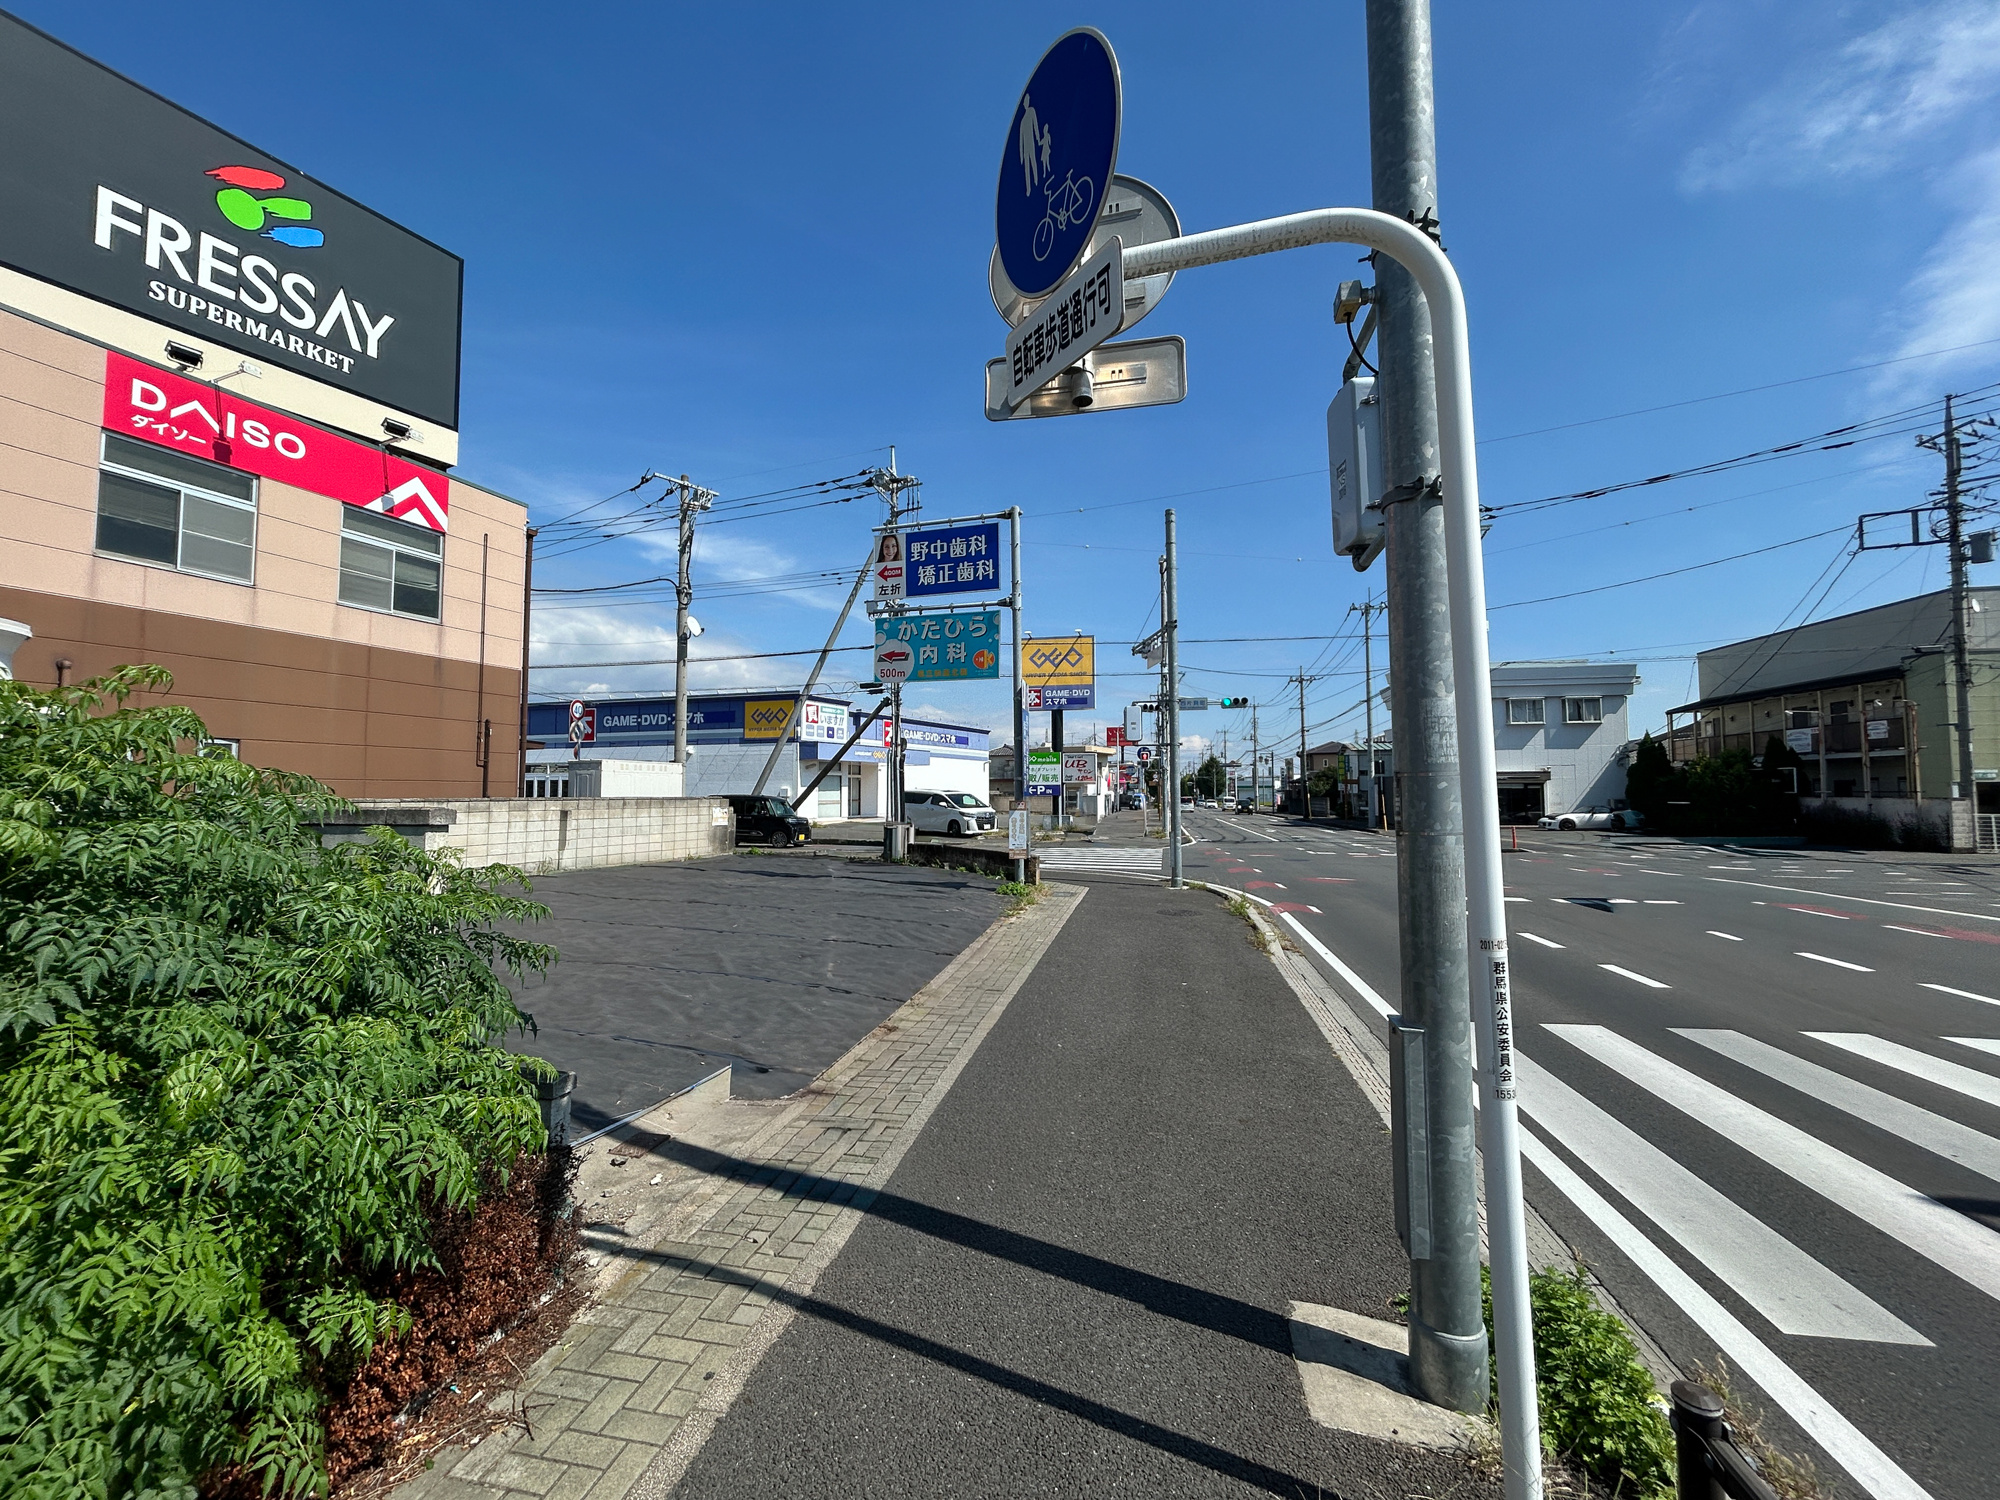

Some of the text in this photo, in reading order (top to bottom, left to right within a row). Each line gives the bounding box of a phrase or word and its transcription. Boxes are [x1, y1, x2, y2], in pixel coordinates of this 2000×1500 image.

[93, 184, 396, 359] FRESSAY
[148, 279, 355, 374] SUPERMARKET
[1012, 262, 1111, 387] 自転車歩道通行可
[130, 414, 206, 444] ダイソー
[131, 378, 307, 460] DAISO
[911, 534, 987, 562] 野中歯科
[918, 559, 995, 585] 矯正歯科
[878, 583, 901, 596] 左折
[898, 615, 987, 640] かたひら
[919, 642, 967, 665] 内科
[1029, 647, 1084, 669] GEO
[880, 668, 906, 678] 500m
[574, 705, 583, 715] 40
[751, 707, 788, 724] GEO
[1064, 760, 1087, 768] UB
[1037, 786, 1045, 794] P
[1493, 962, 1512, 1082] 群馬県公安委員会
[1495, 1089, 1516, 1100] 1553
